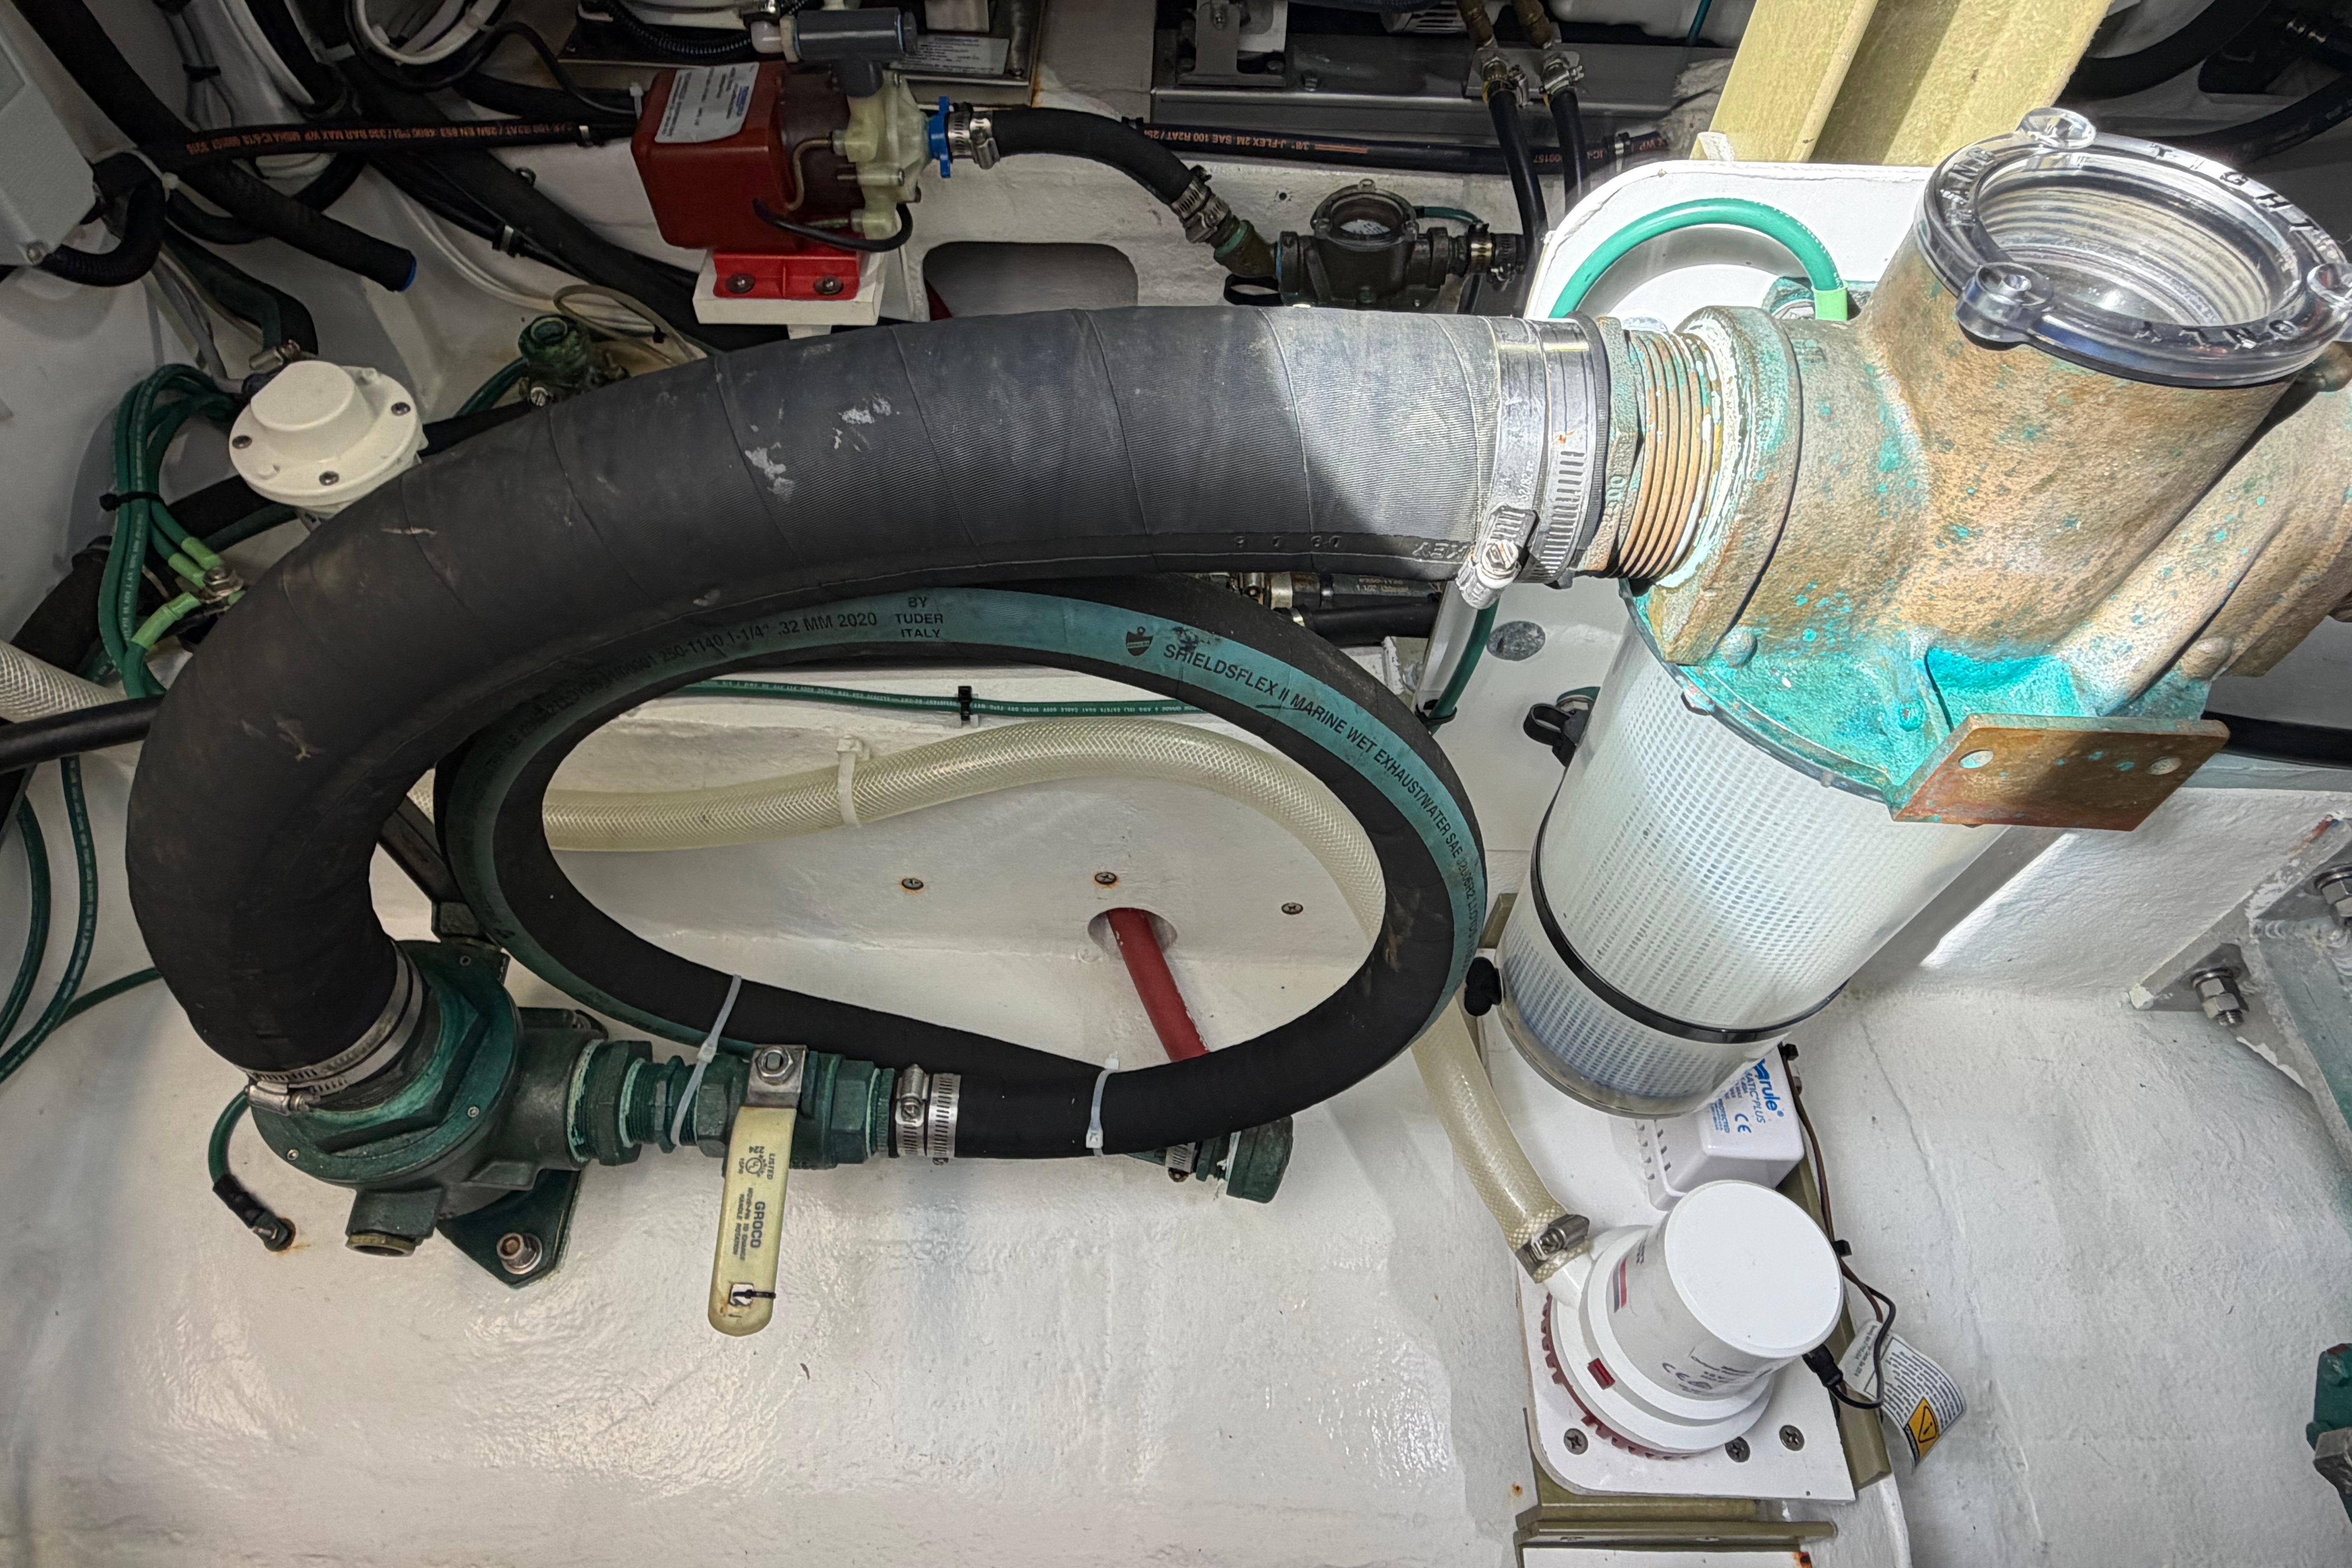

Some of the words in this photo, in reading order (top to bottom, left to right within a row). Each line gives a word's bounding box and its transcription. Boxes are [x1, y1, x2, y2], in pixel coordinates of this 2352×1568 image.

[1167, 131, 1191, 141] R2AT
[1193, 133, 1209, 142] 100
[1212, 133, 1232, 144] SAE
[1237, 136, 1250, 145] 2M
[1253, 137, 1286, 148] J-FLEX
[2134, 321, 2301, 350] ONLY
[908, 597, 927, 608] BY
[803, 615, 833, 631] MM
[837, 612, 877, 627] 2020
[894, 613, 943, 624] TUDER
[901, 629, 940, 638] ITALY
[1164, 644, 1278, 696] SHIELDSFLEX
[1290, 693, 1348, 734] MARINE
[1346, 726, 1377, 754] WET
[1374, 749, 1453, 836] EXHAUST/WATER
[1446, 833, 1463, 859] SAE
[1752, 1100, 1766, 1124] PLUS
[767, 1153, 776, 1180] LISTED
[737, 1194, 745, 1220] HANDLE
[750, 1201, 765, 1248] GROCO
